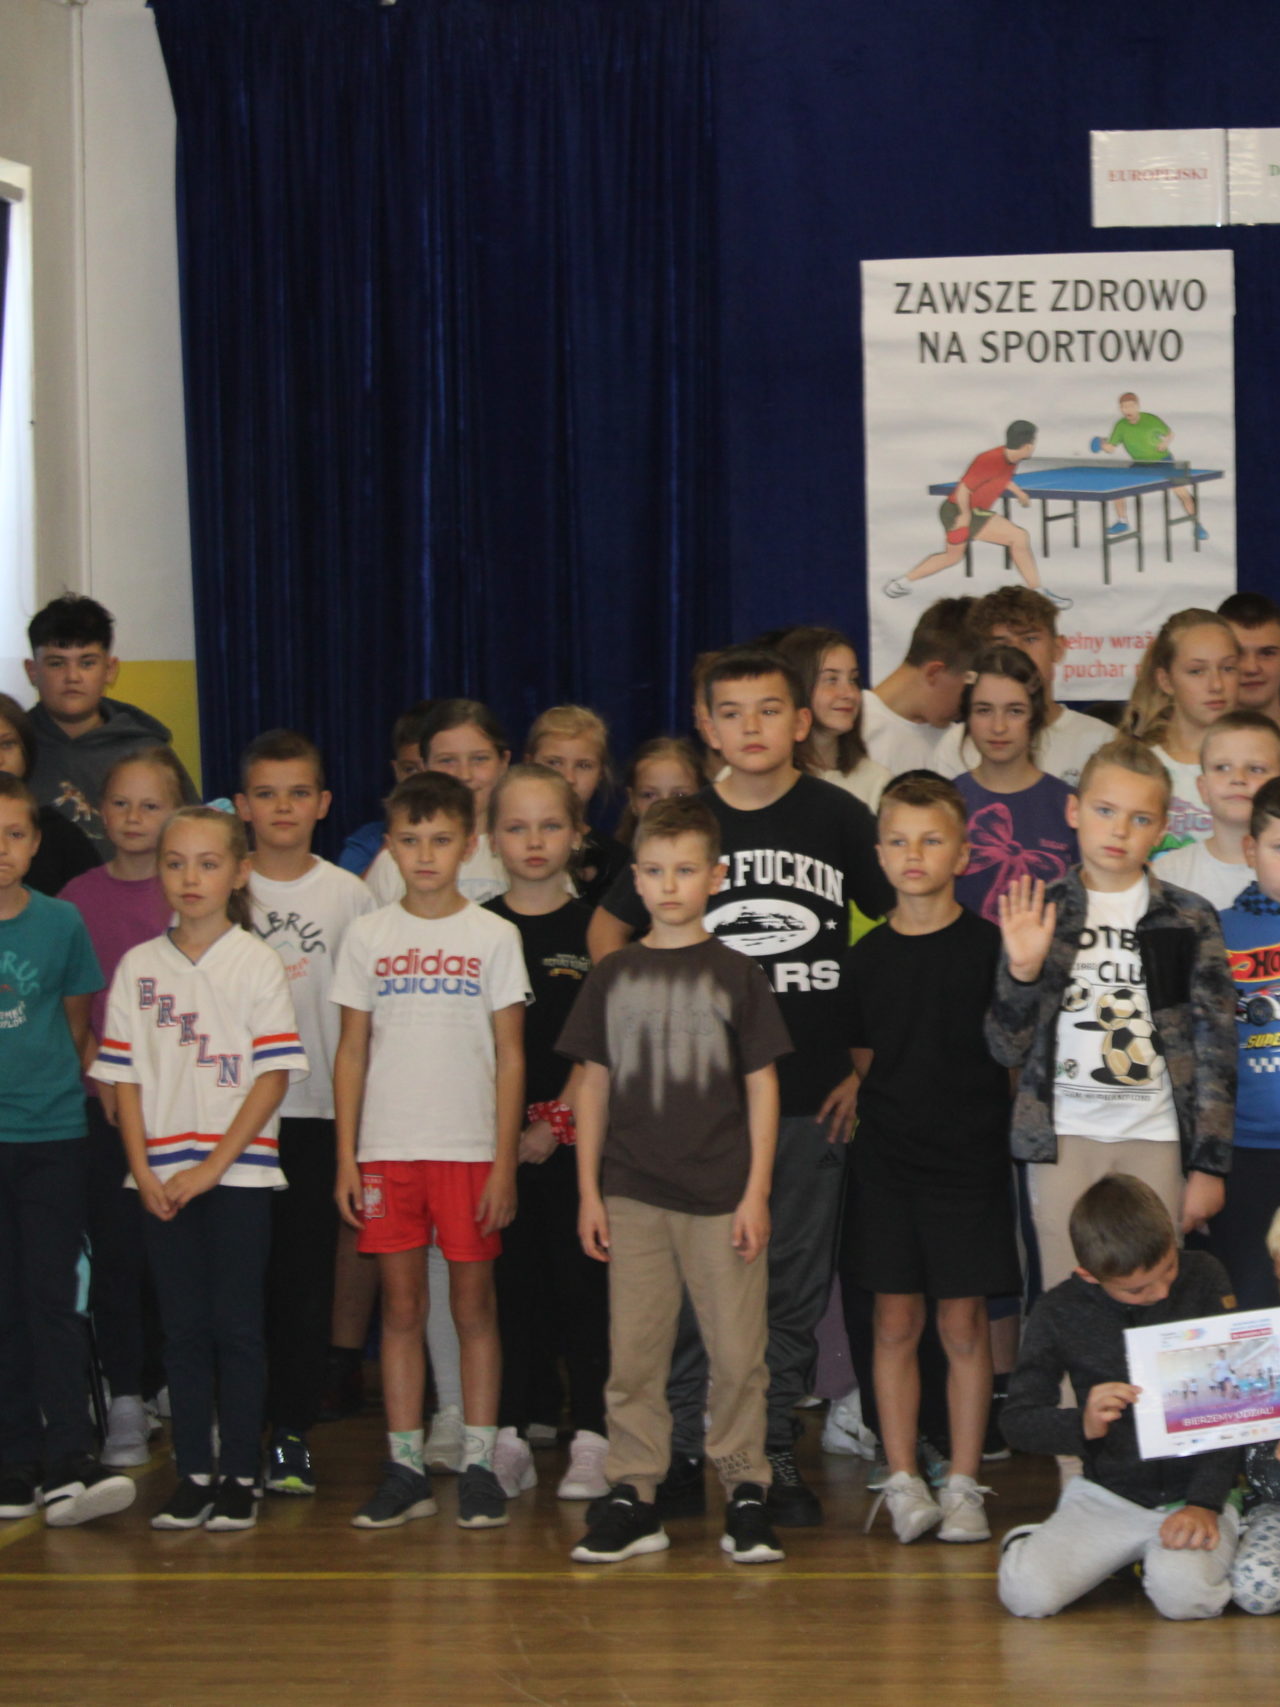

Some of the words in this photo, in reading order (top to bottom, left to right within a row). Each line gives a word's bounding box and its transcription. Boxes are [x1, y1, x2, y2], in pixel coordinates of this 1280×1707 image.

[894, 281, 1037, 314] ZAWSZE
[1049, 278, 1207, 312] ZDROWO
[918, 331, 967, 364] NA
[979, 328, 1184, 364] SPORTOWO
[1062, 659, 1127, 682] puchar
[733, 849, 845, 908] FUCKIN
[374, 948, 482, 978] adidas
[768, 960, 841, 993] RS
[138, 977, 242, 1088] BRKLN
